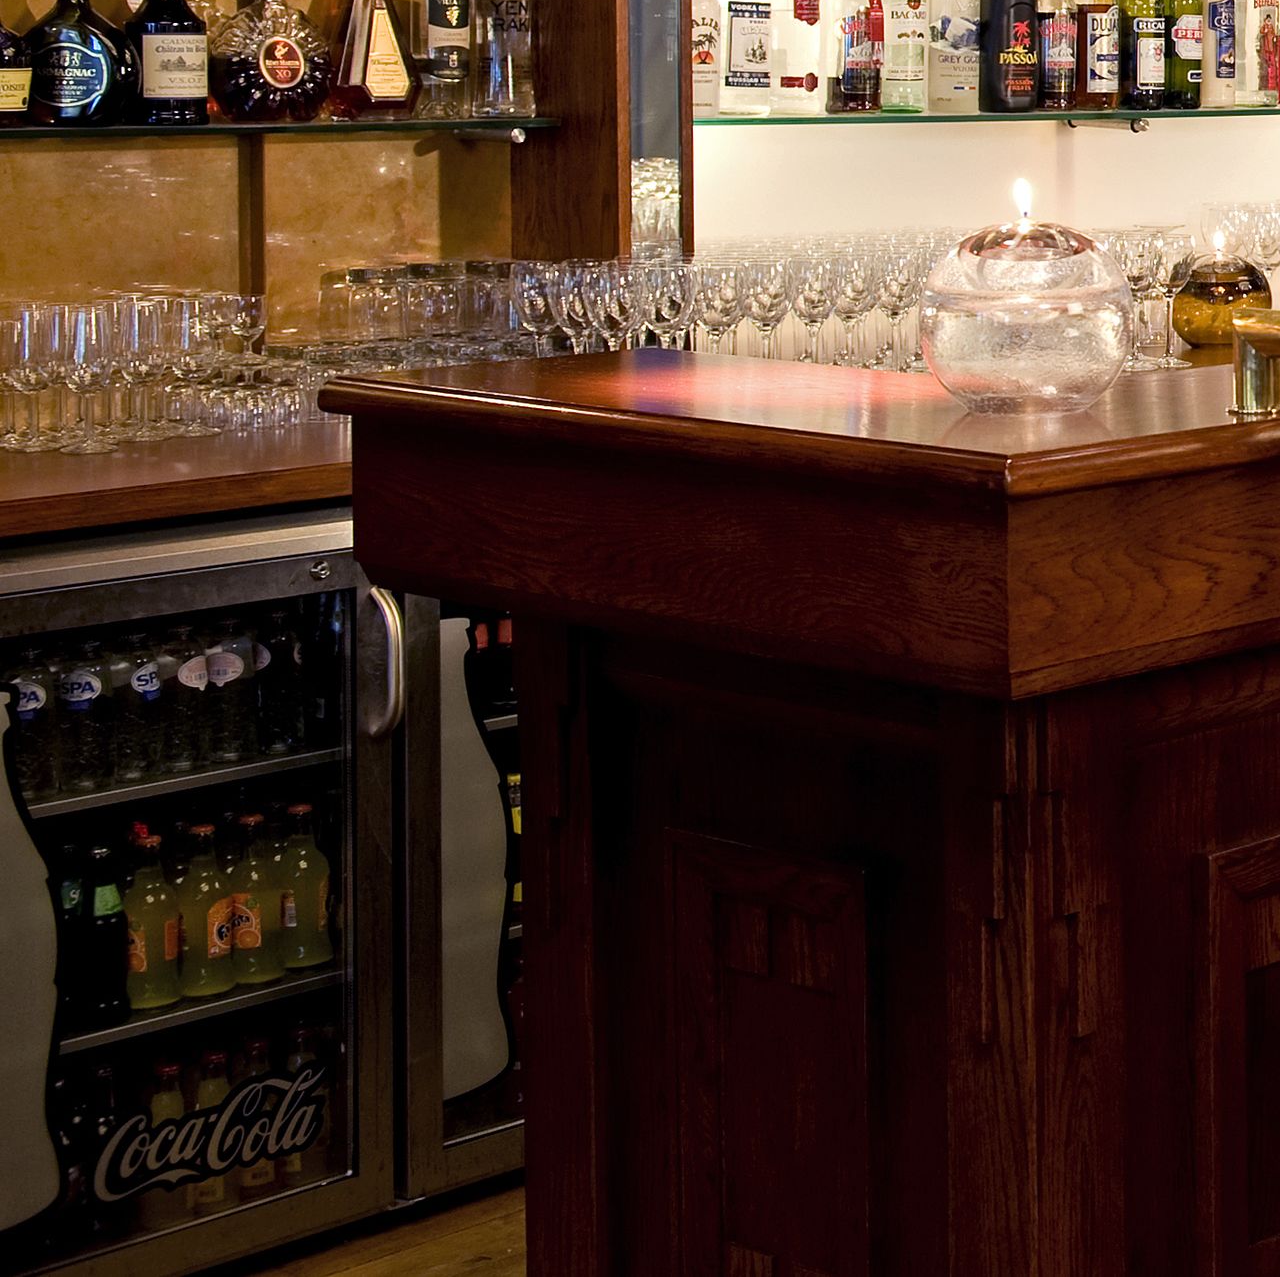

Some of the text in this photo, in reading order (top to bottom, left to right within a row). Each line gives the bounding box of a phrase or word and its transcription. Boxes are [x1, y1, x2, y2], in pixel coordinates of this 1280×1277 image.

[938, 54, 961, 63] GREY
[274, 69, 291, 79] XO
[60, 680, 95, 696] SPA
[18, 689, 40, 705] PA
[94, 1067, 326, 1203] Coca-Cola
